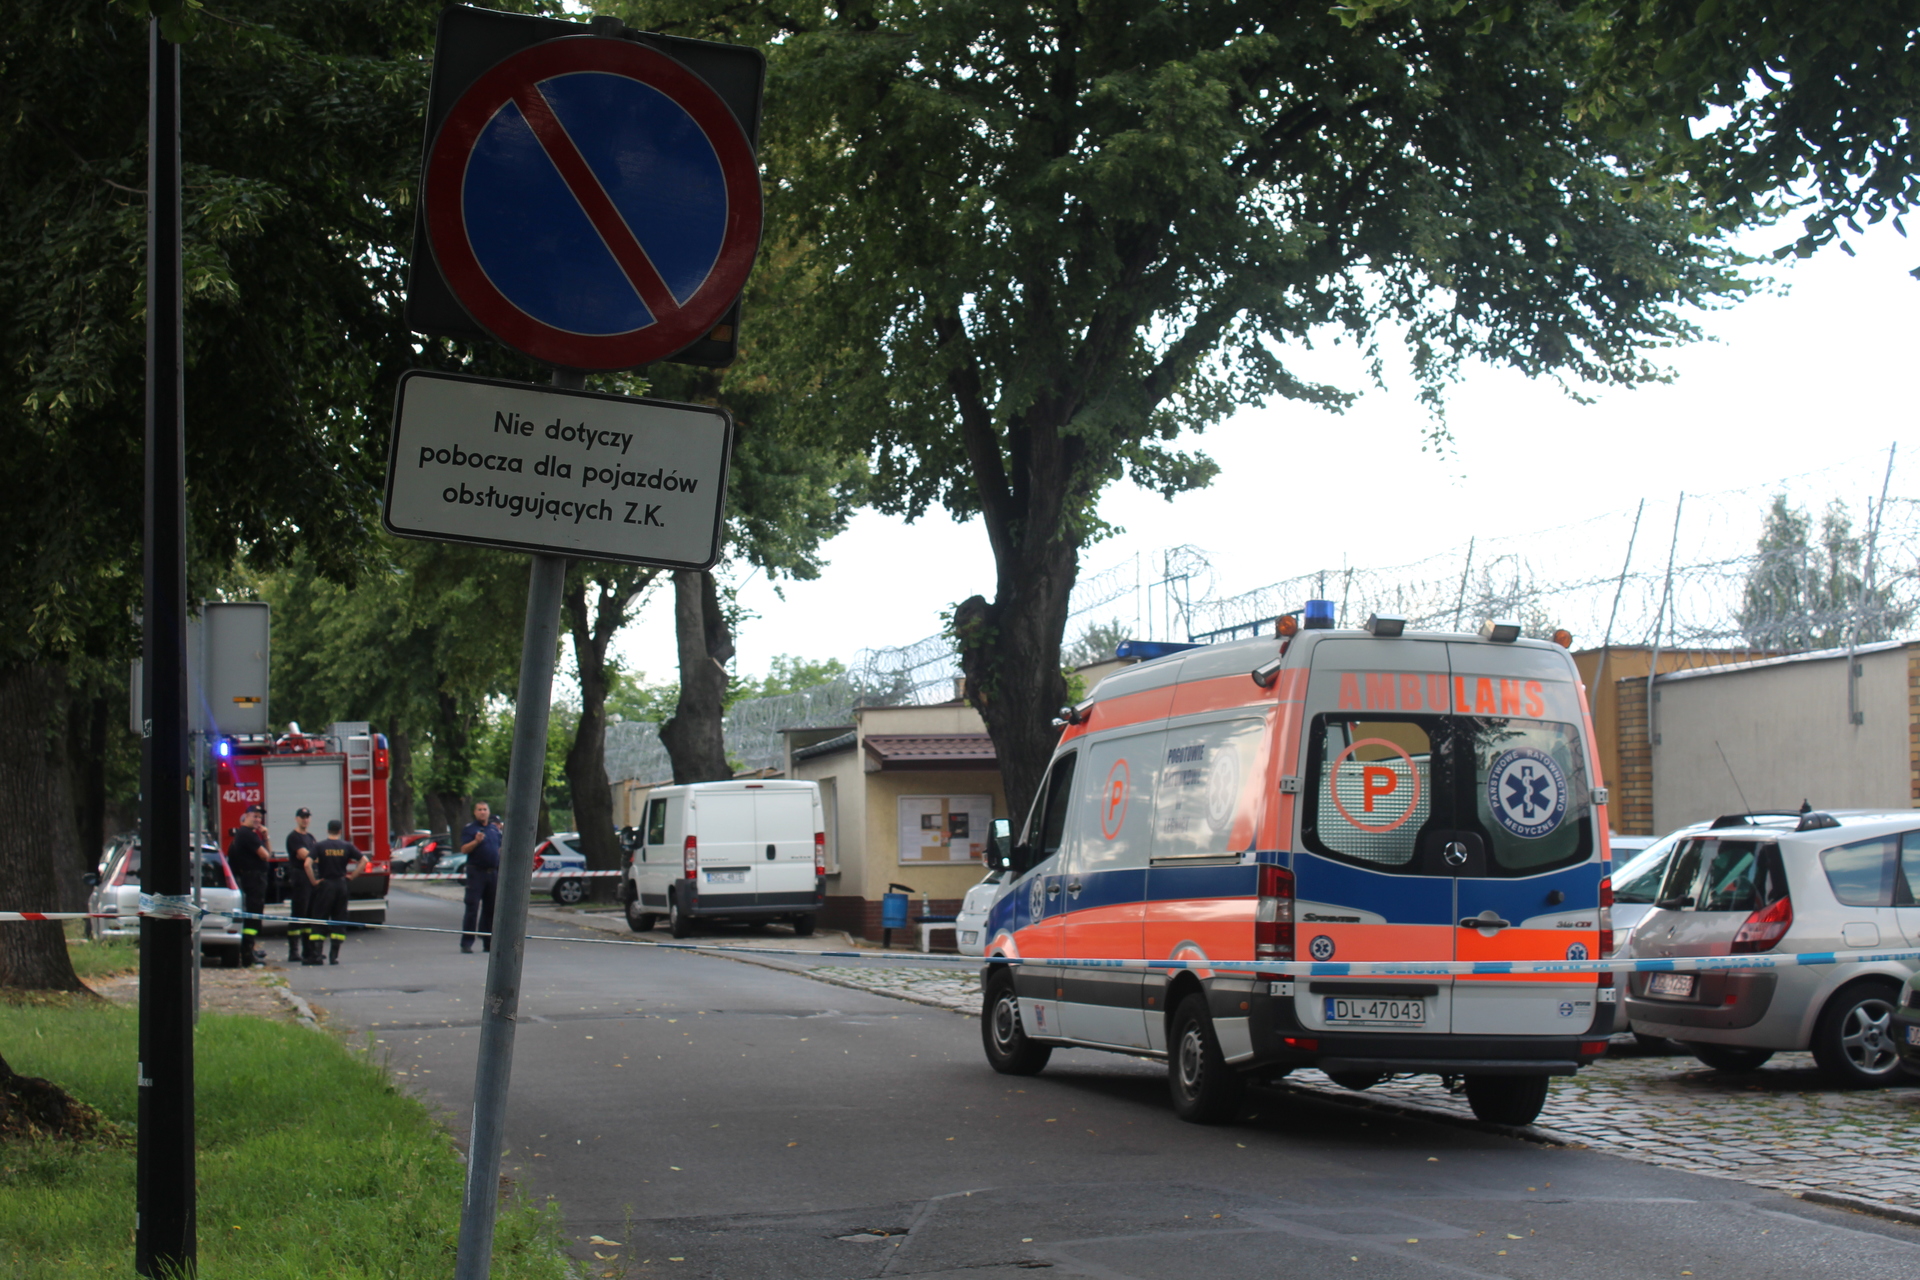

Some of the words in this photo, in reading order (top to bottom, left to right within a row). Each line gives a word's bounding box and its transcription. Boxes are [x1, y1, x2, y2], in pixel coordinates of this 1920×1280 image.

[493, 410, 535, 437] Nie
[544, 418, 634, 455] dotyczy
[418, 443, 523, 474] pobocza
[533, 454, 572, 479] dla
[581, 462, 698, 494] pojazdów
[442, 482, 613, 525] obsługujących
[623, 501, 665, 528] Z.K.
[1338, 672, 1545, 718] AMBULANS
[1108, 780, 1124, 821] P
[1363, 766, 1398, 813] P
[1526, 749, 1566, 812] RATOWNICTWO
[1504, 817, 1555, 835] MEDYCZNE
[1337, 1001, 1361, 1018] DL
[1368, 1001, 1421, 1019] 47043
